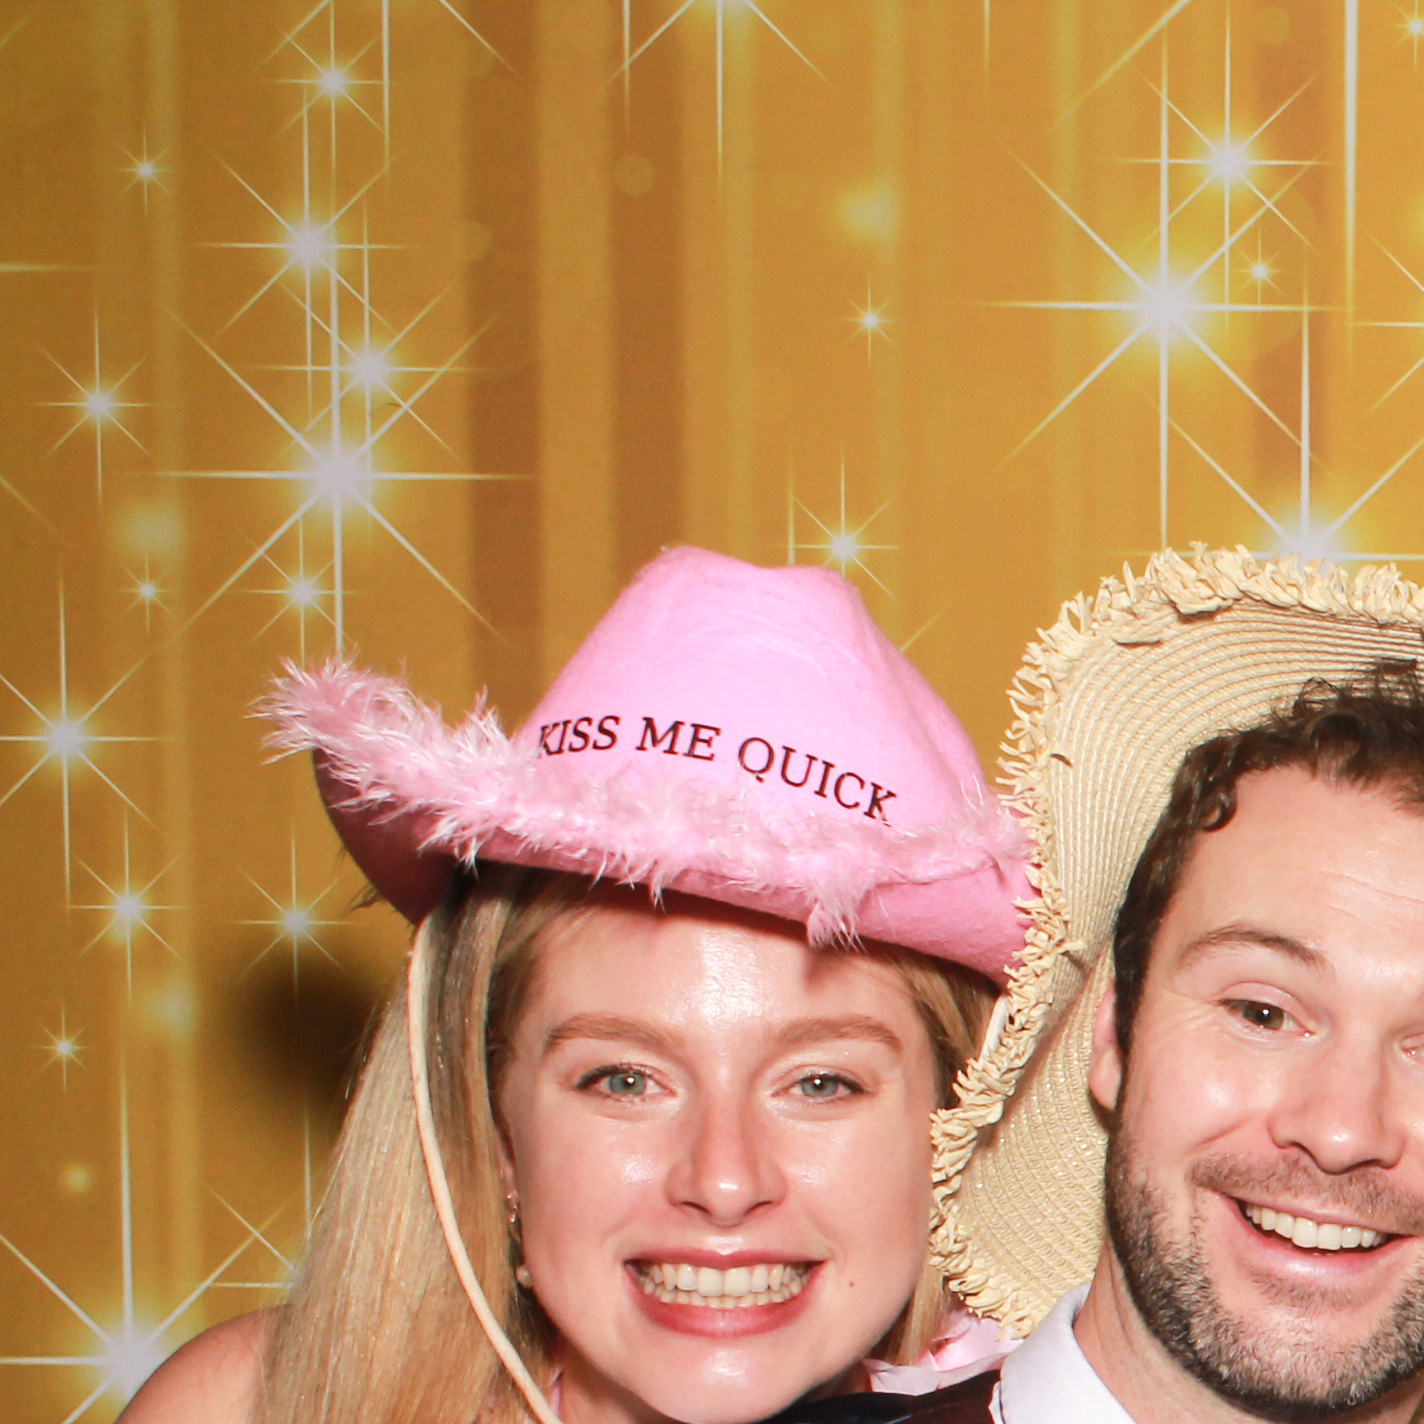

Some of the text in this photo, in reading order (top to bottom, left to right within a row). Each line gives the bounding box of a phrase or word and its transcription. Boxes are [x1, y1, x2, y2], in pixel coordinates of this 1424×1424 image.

[539, 715, 897, 826] KISS ME QUICK
